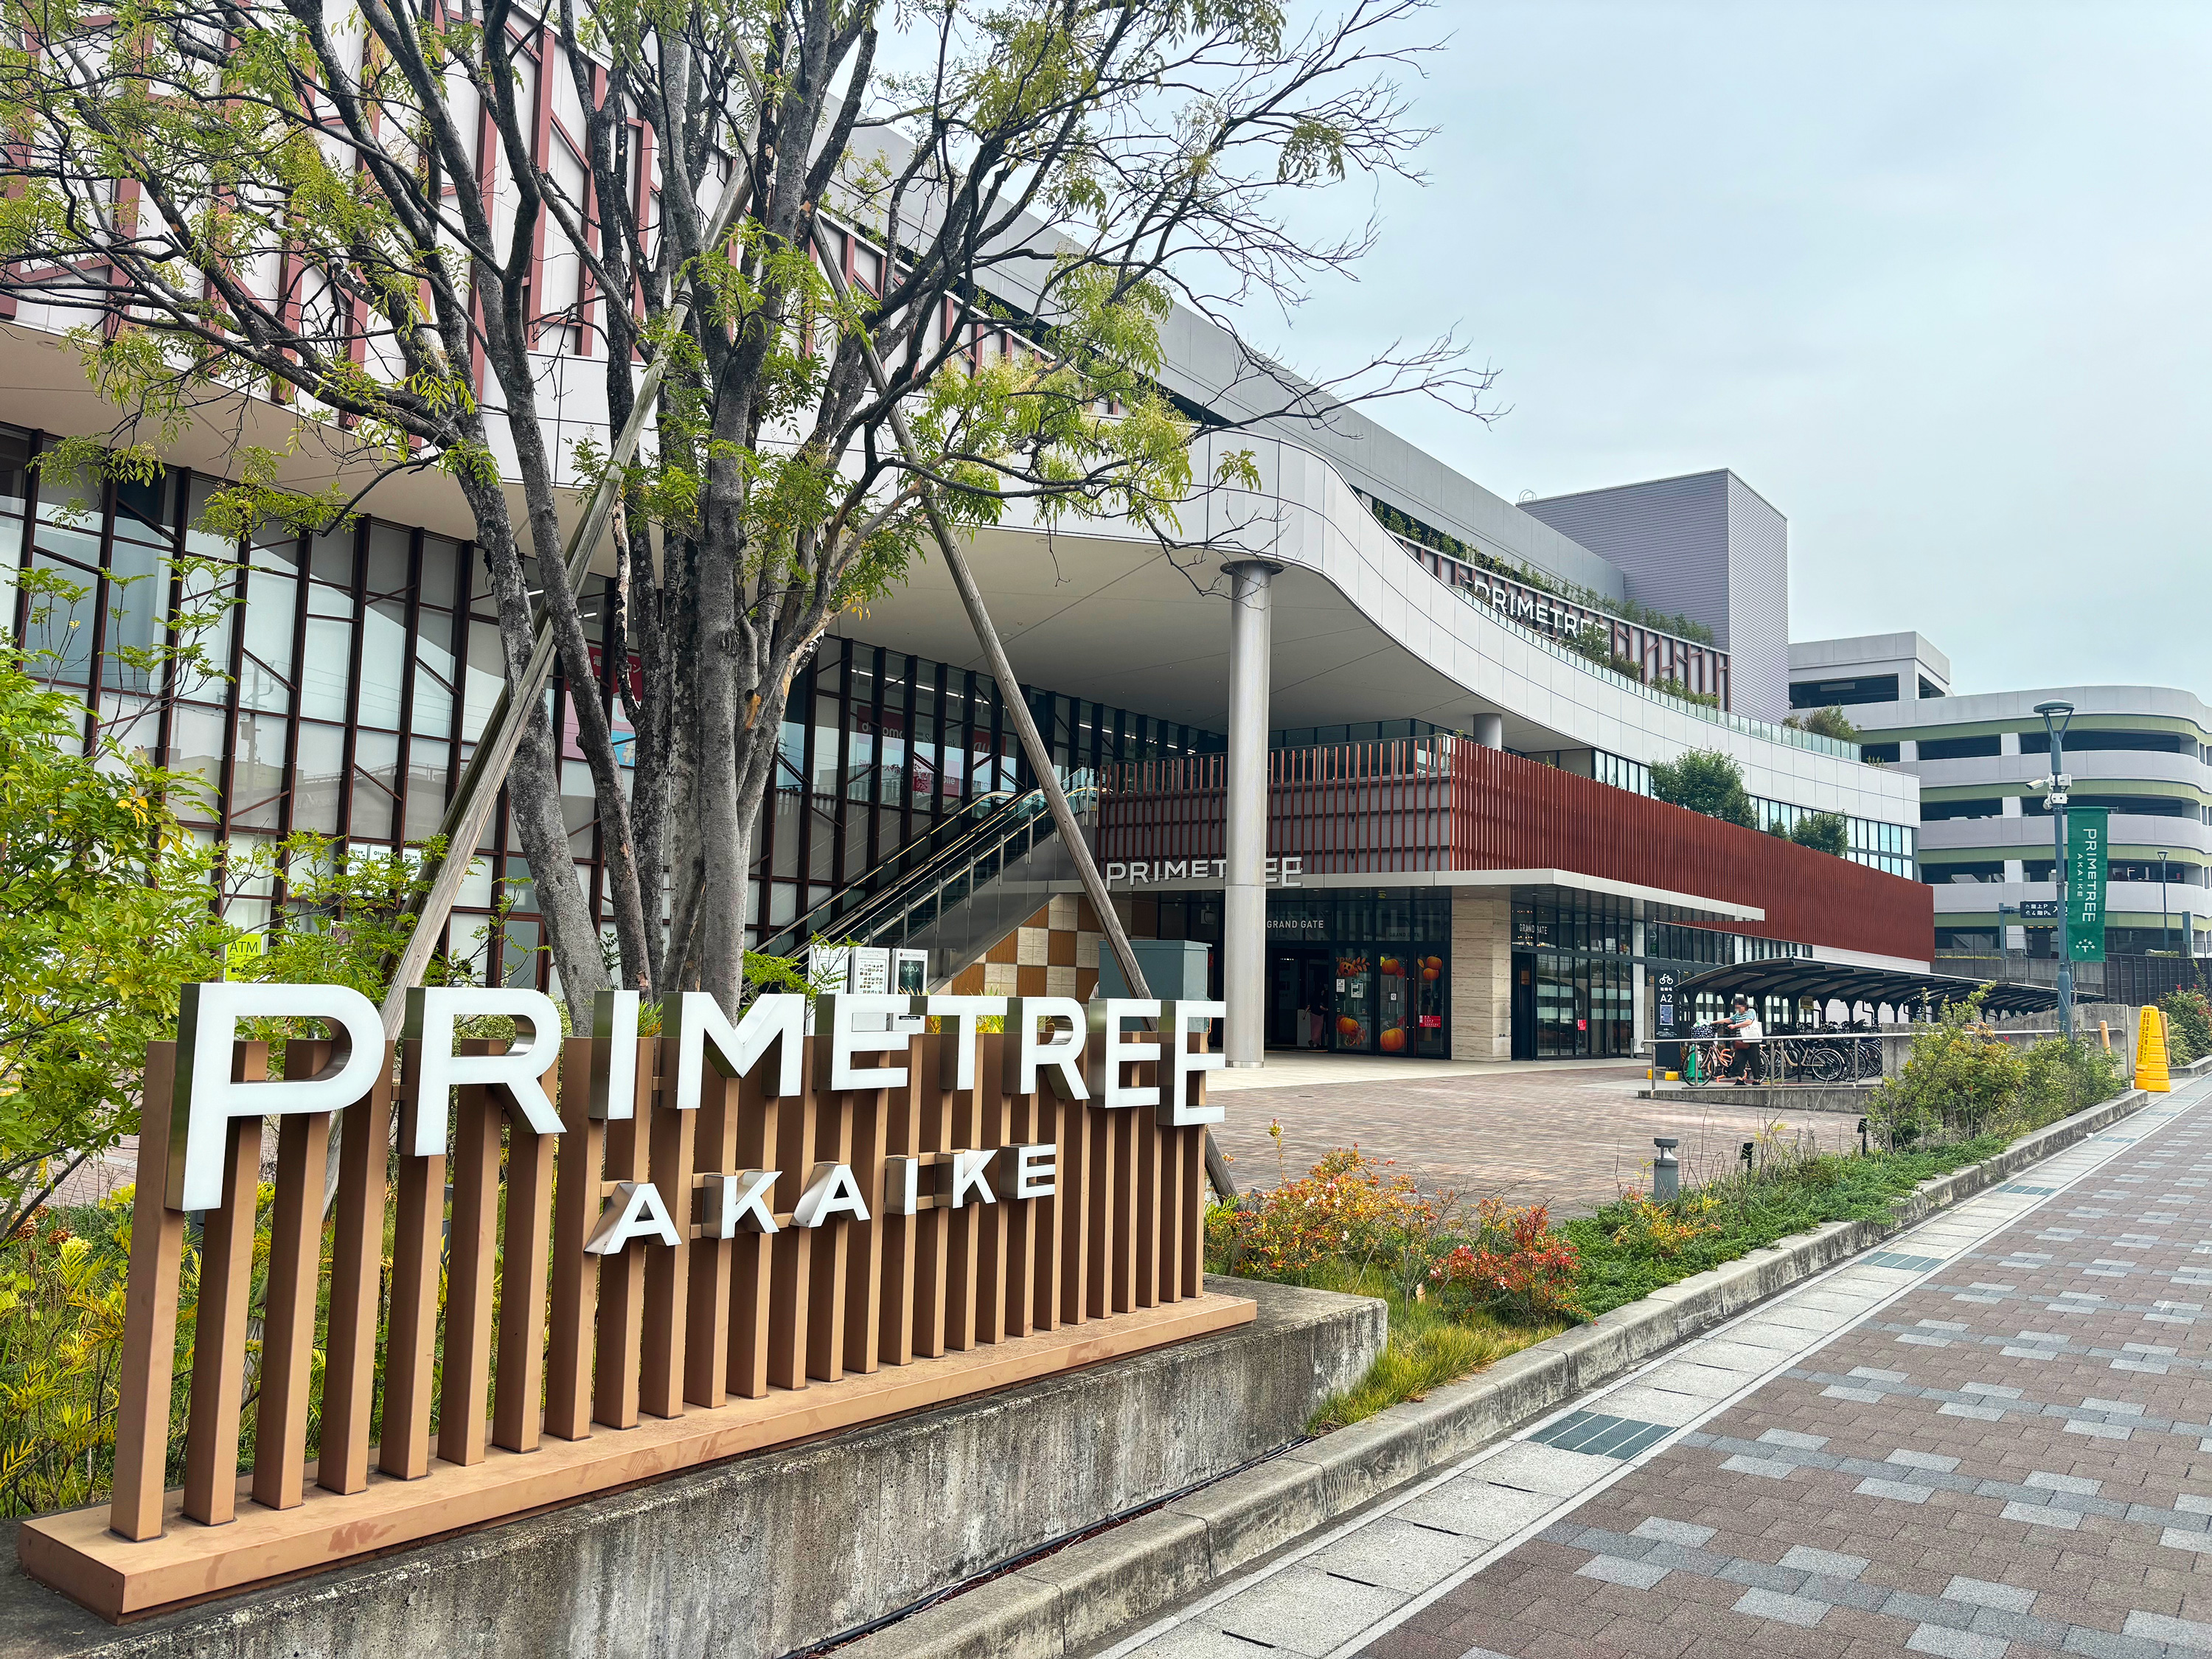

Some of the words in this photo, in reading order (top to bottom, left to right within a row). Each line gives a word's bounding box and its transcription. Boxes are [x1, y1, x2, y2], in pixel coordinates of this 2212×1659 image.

[1107, 857, 1303, 891] PRIMETEE
[2082, 828, 2097, 922] PRIMETREE
[1266, 920, 1298, 929] GRAND
[1301, 919, 1324, 929] GATE
[1519, 923, 1535, 934] GRAND
[229, 941, 258, 953] ATM
[1660, 994, 1673, 1004] A2
[181, 982, 1227, 1211] PRIMETREE
[599, 1143, 1057, 1255] AKAIKE
